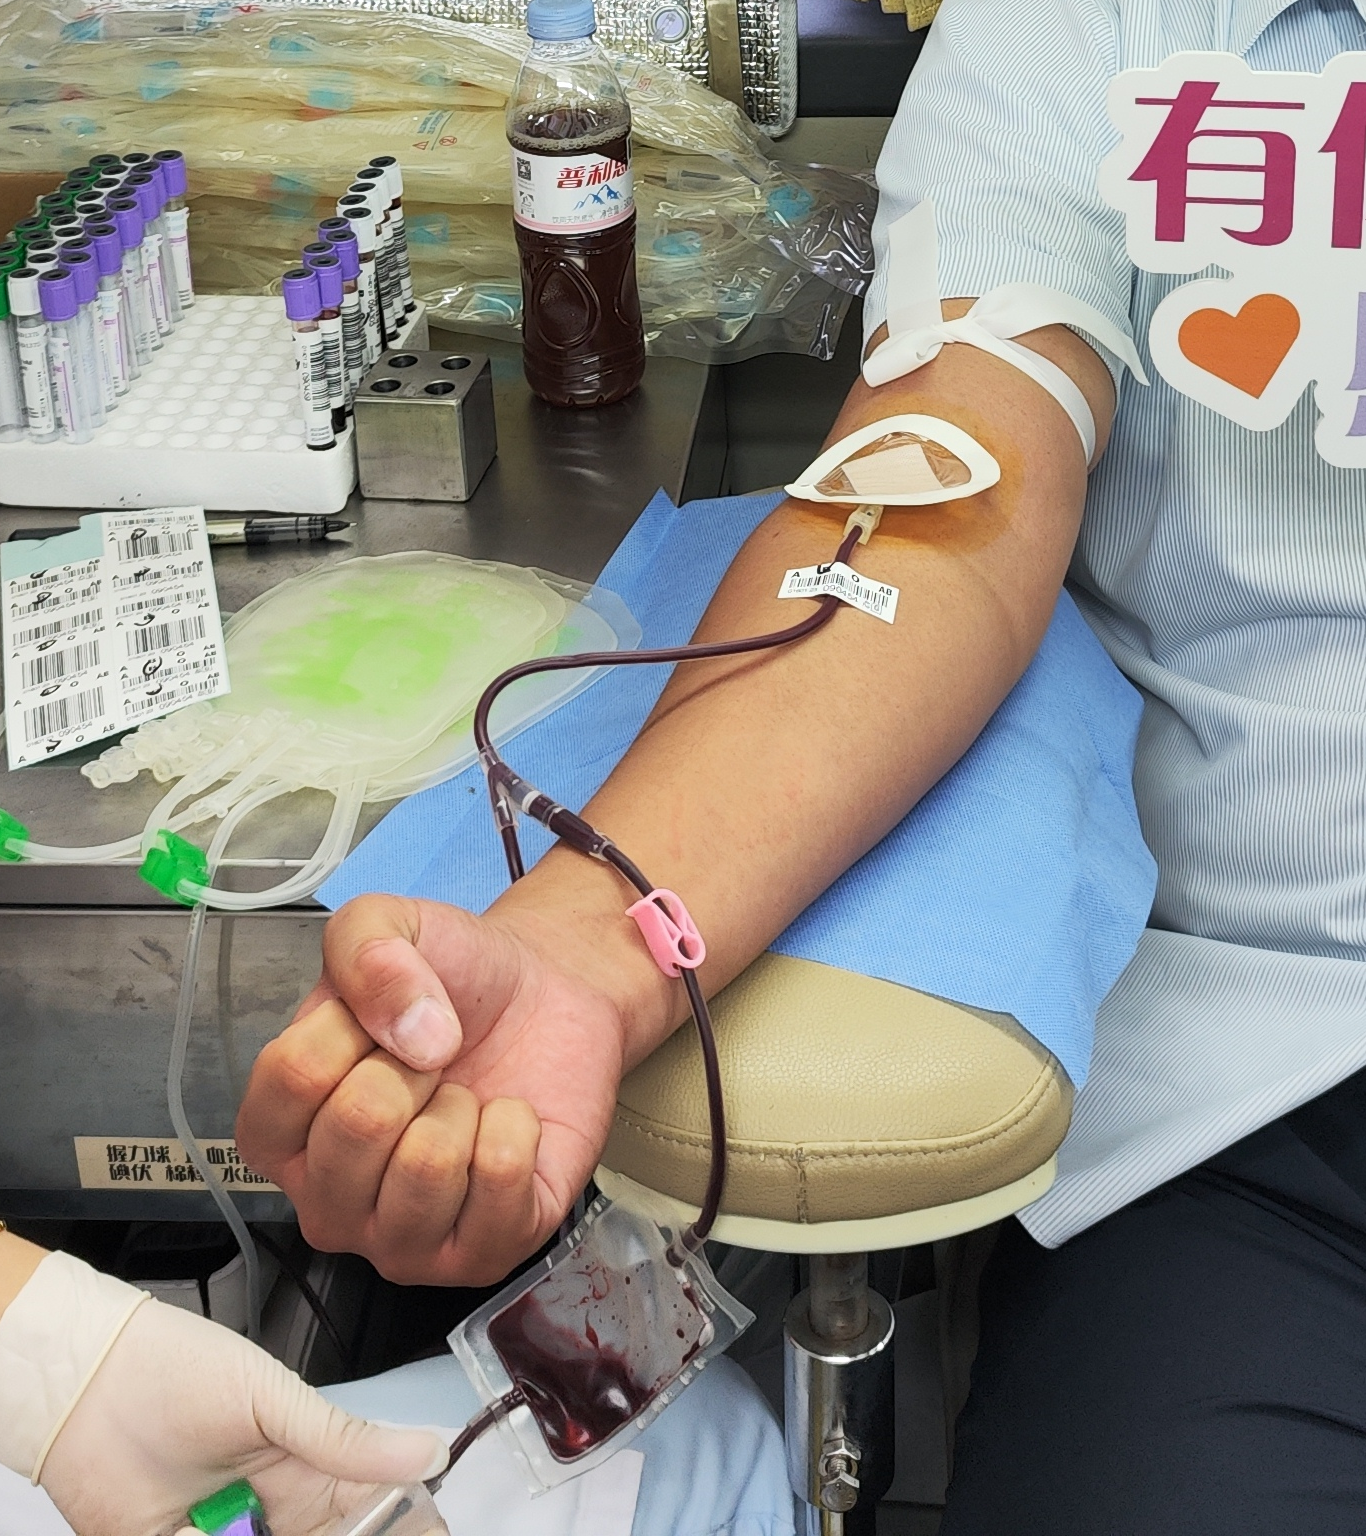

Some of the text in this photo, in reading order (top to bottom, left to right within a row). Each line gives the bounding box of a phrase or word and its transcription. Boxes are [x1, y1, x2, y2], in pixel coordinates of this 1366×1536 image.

[106, 1144, 172, 1163] 握力球
[109, 1164, 154, 1182] 碘伏
